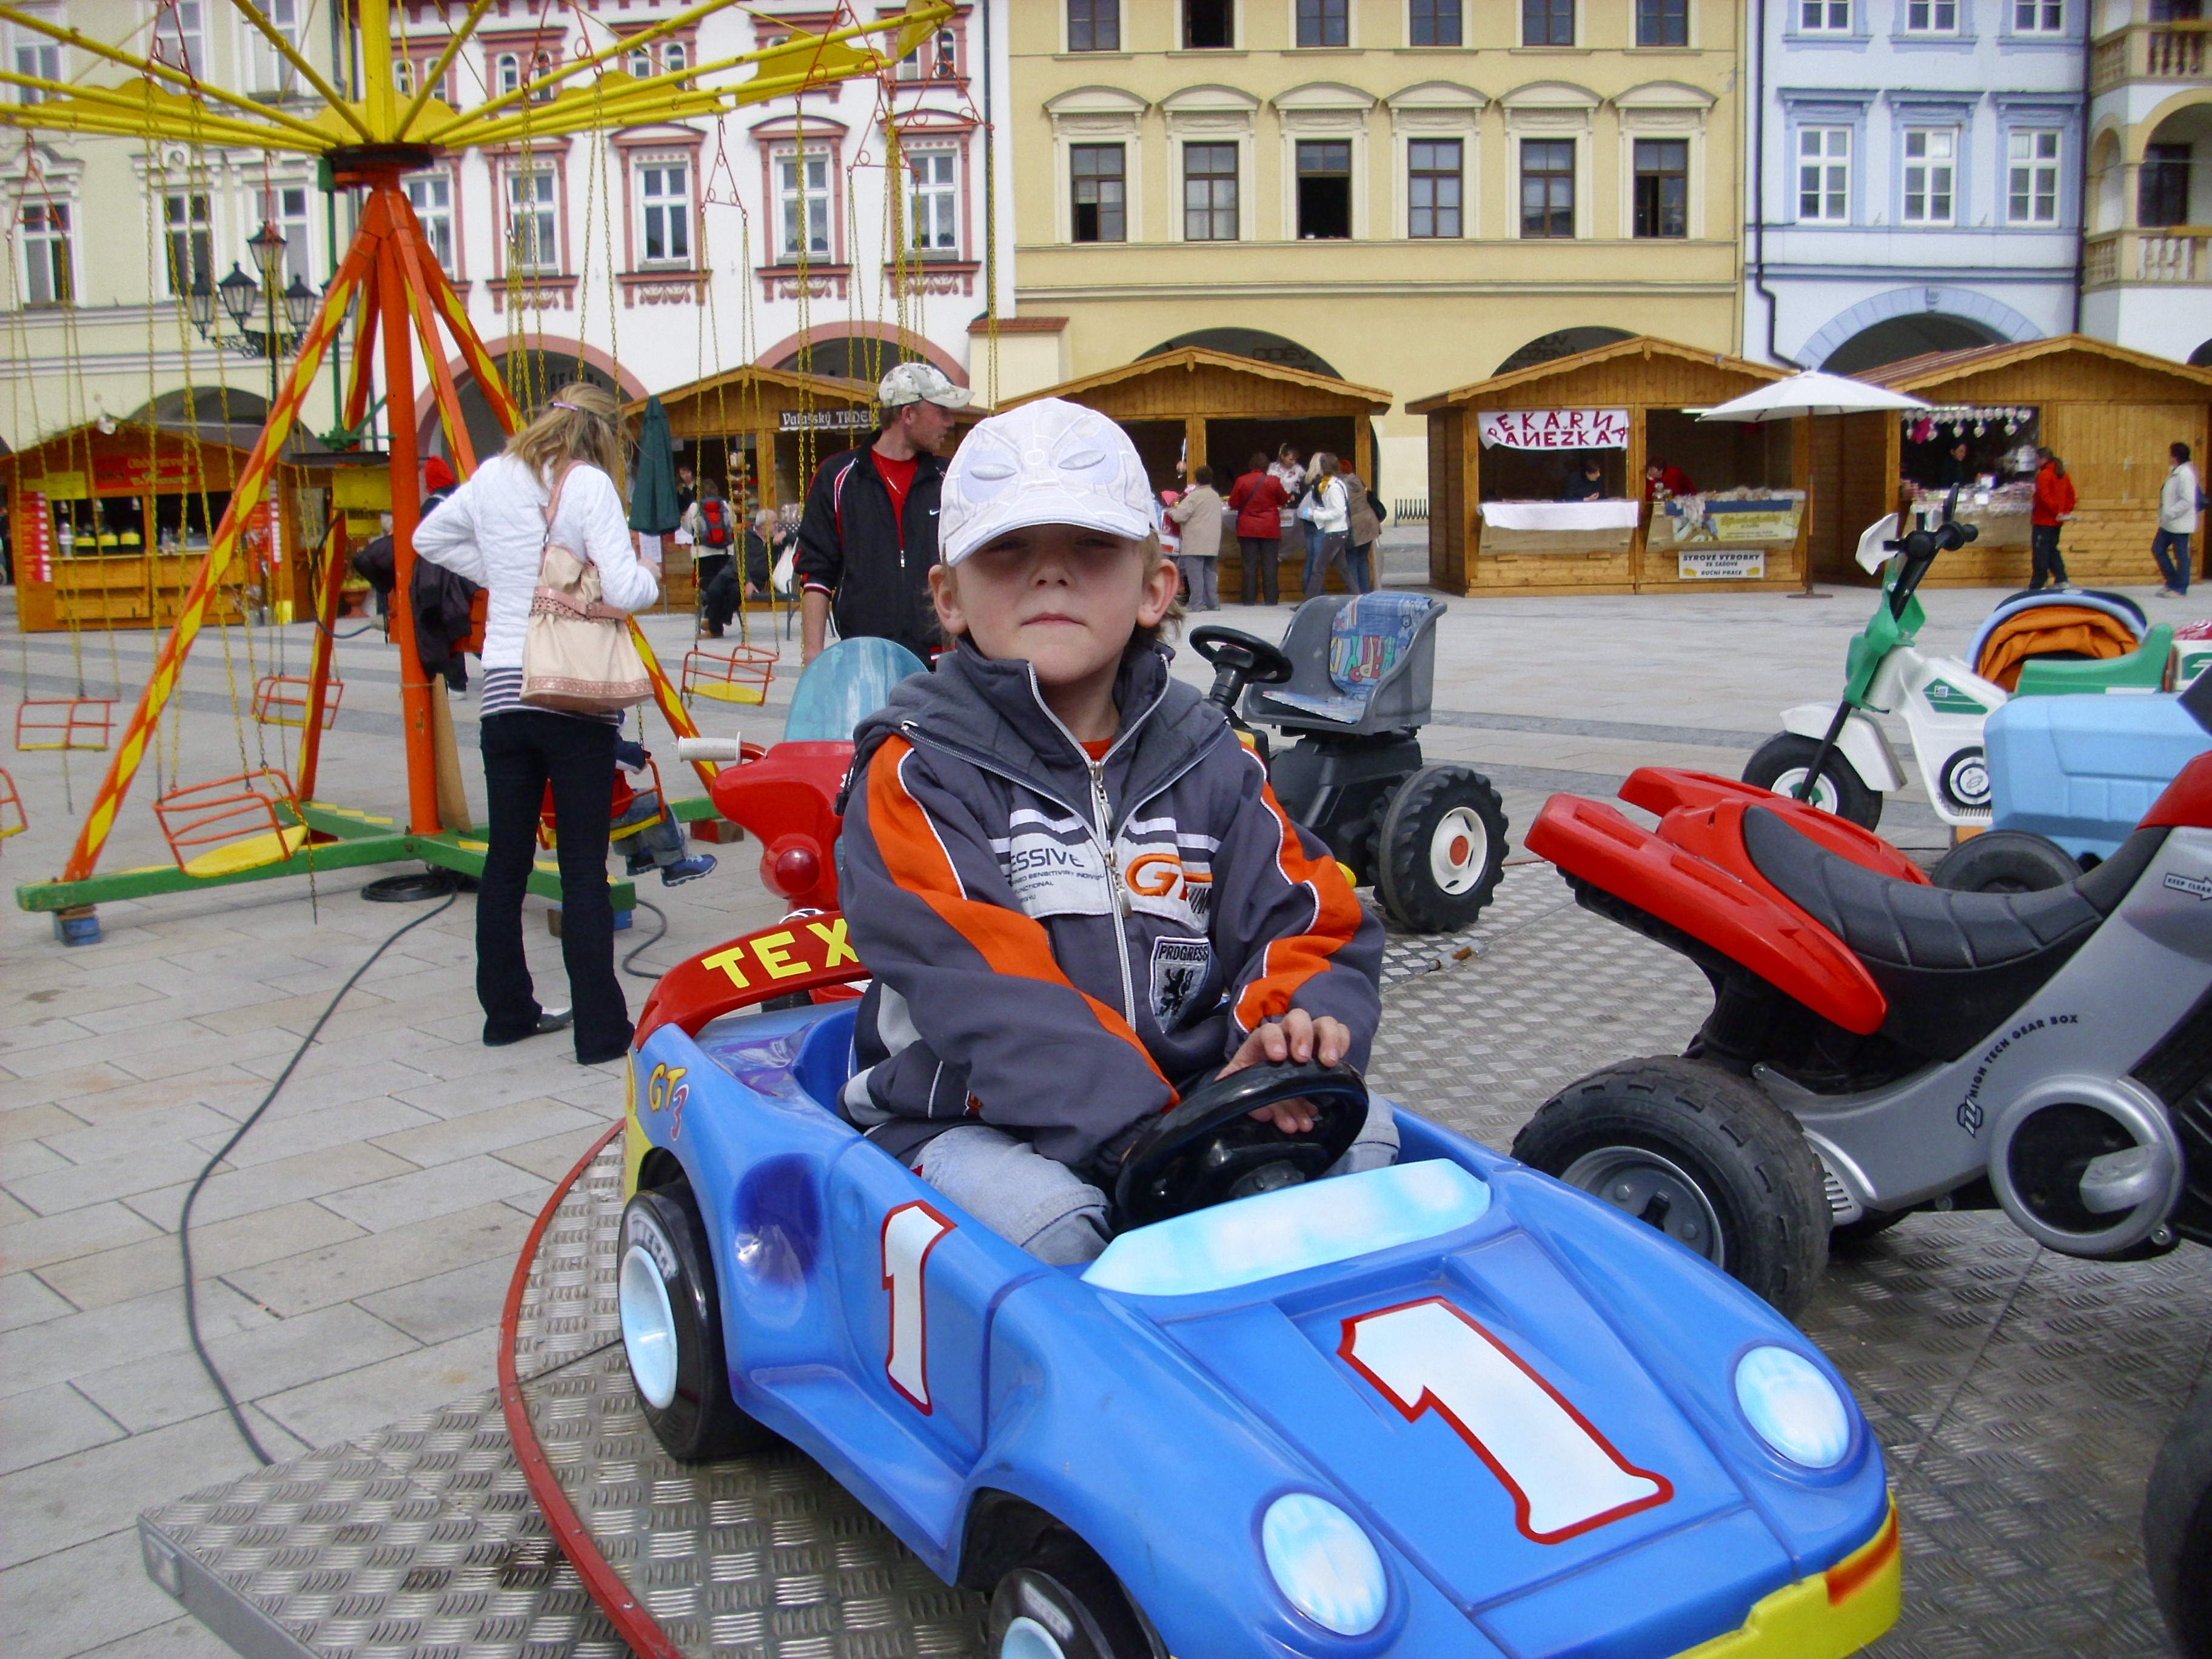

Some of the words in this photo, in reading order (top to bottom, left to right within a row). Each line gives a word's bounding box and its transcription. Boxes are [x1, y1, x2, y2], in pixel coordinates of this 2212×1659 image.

[1158, 943, 1208, 961] PROGRESS
[1969, 1066, 1987, 1098] HIGH
[1983, 1038, 2010, 1064] TECH
[2012, 1019, 2045, 1039] GEAR
[2049, 1014, 2078, 1025] BOX
[882, 1199, 957, 1416] 1
[1336, 1295, 1675, 1545] 1
